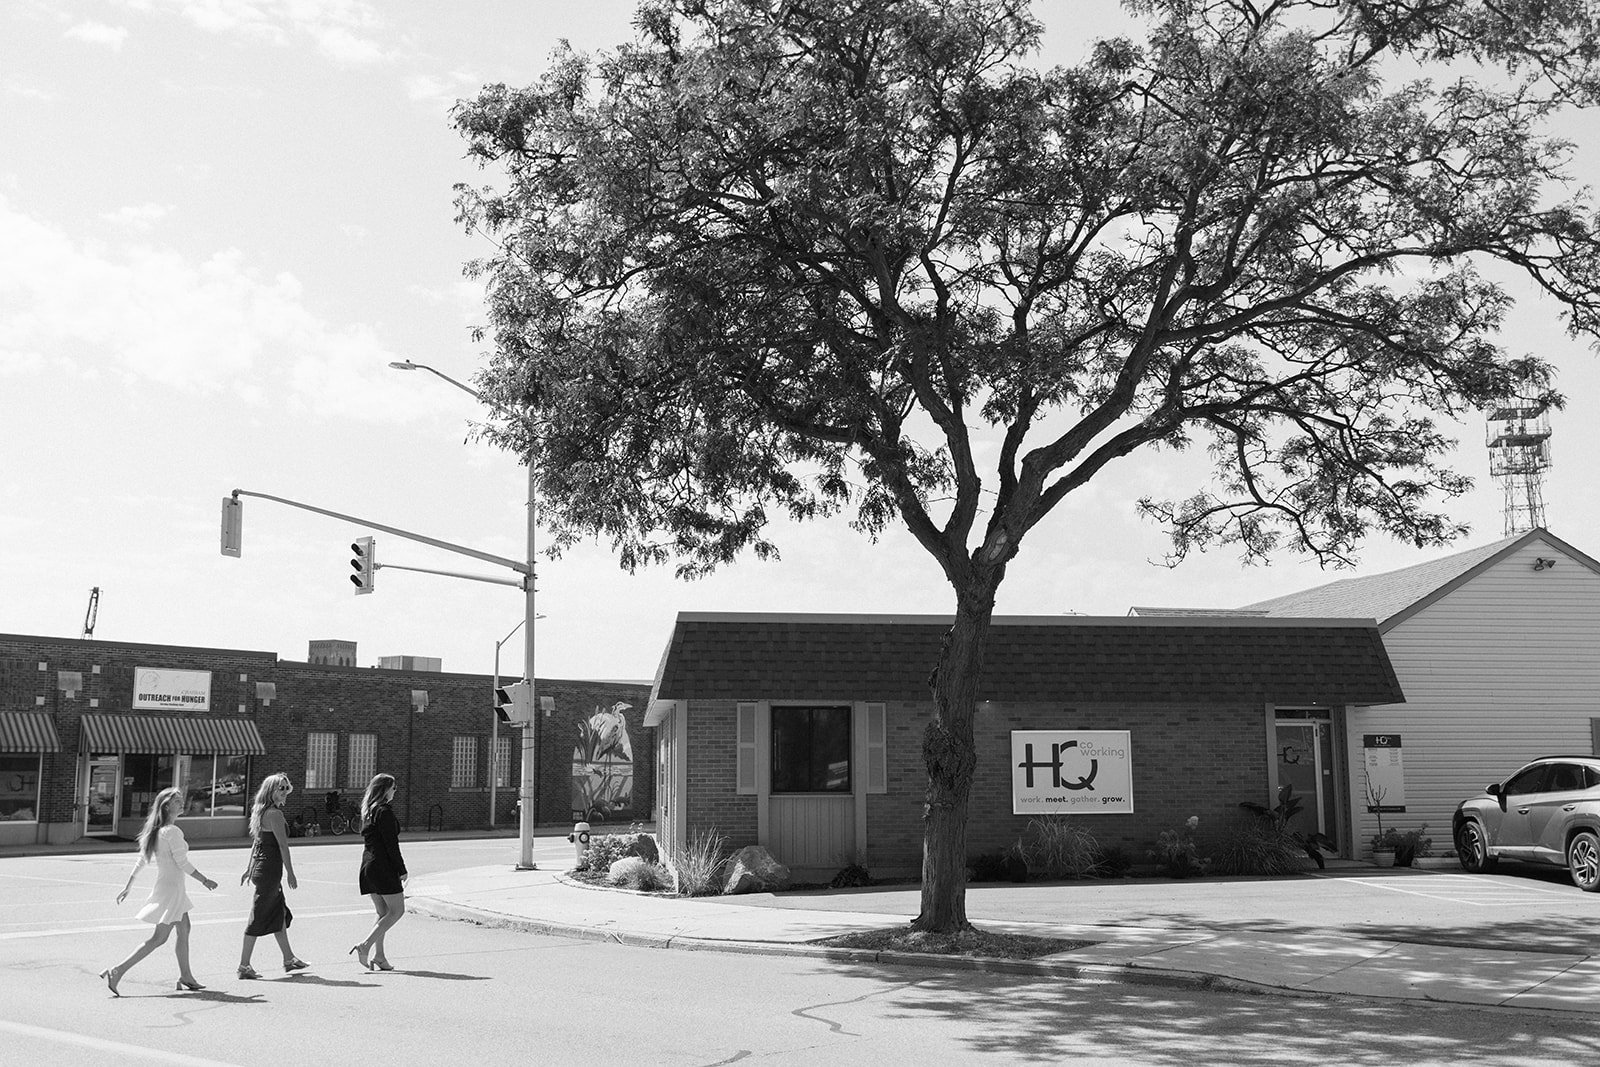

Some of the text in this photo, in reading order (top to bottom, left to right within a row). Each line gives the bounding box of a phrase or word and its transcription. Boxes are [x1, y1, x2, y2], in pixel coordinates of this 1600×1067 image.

[138, 693, 171, 702] OUTREACH
[181, 695, 206, 704] HUNGER
[1079, 741, 1094, 749] co
[1079, 746, 1125, 760] working
[1018, 740, 1098, 791] HQ
[1070, 795, 1100, 804] gather.
[1101, 796, 1126, 804] grow.
